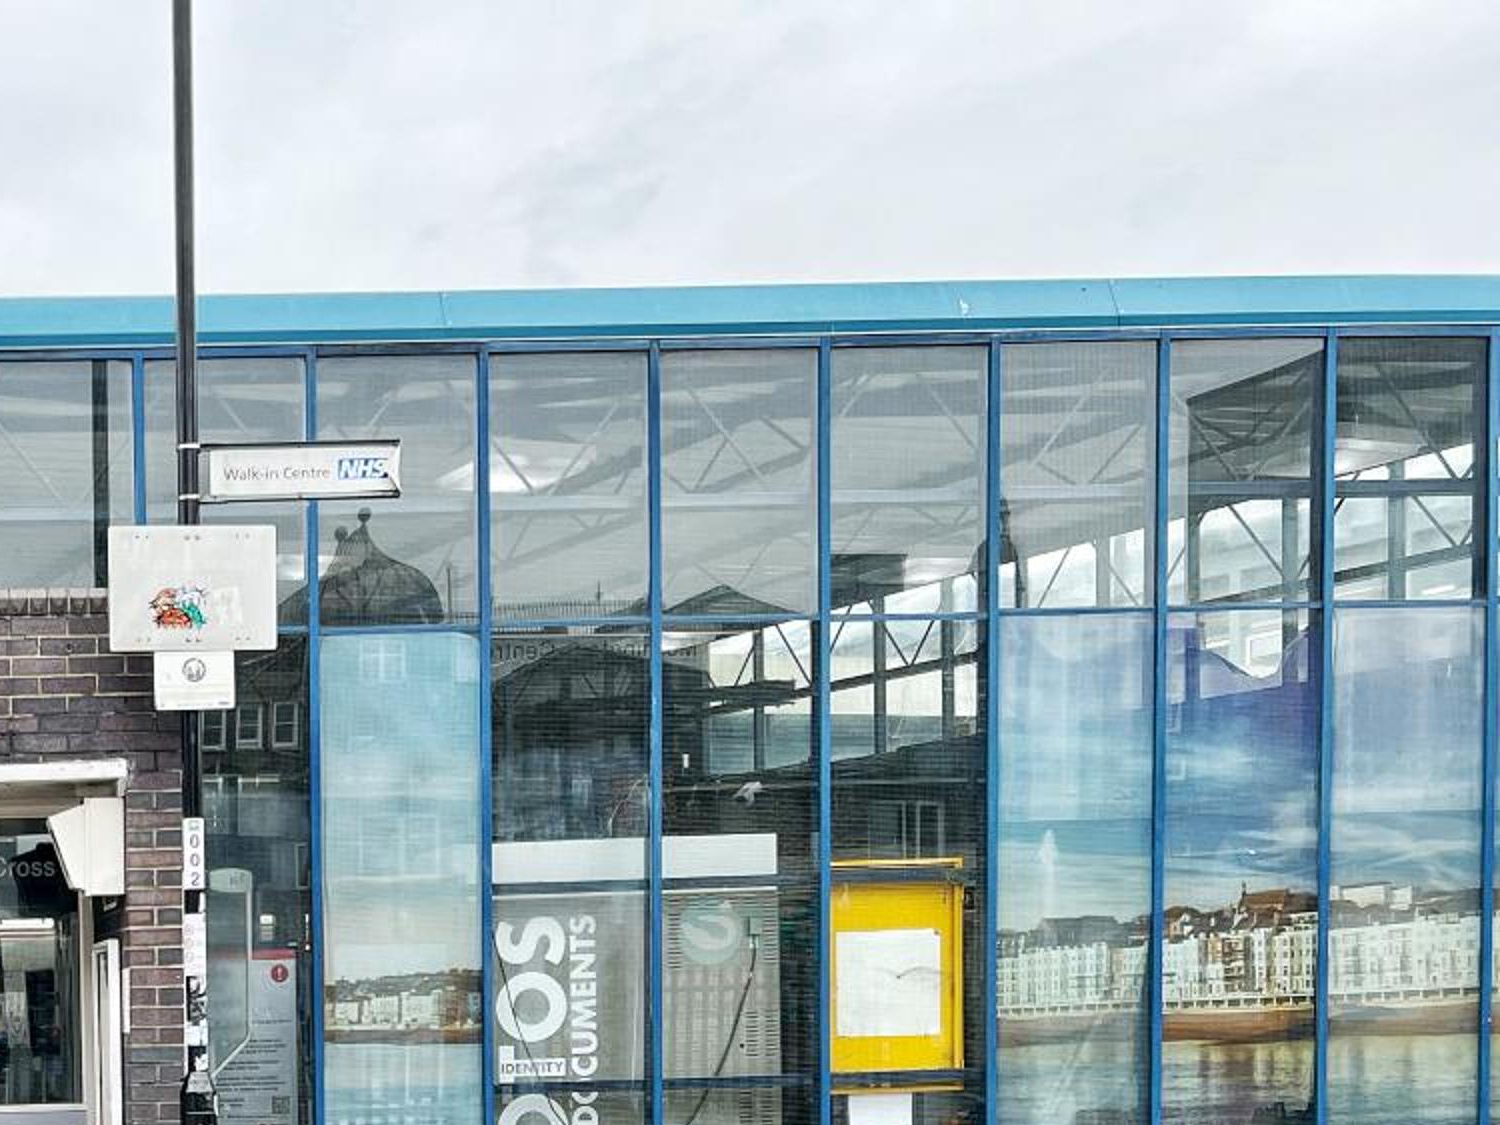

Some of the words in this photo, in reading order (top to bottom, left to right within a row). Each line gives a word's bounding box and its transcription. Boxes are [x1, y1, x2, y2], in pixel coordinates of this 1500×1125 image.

[224, 465, 279, 481] Walk-in
[283, 466, 330, 479] Centre
[340, 459, 387, 478] NHS
[501, 1062, 563, 1074] IDENTITY
